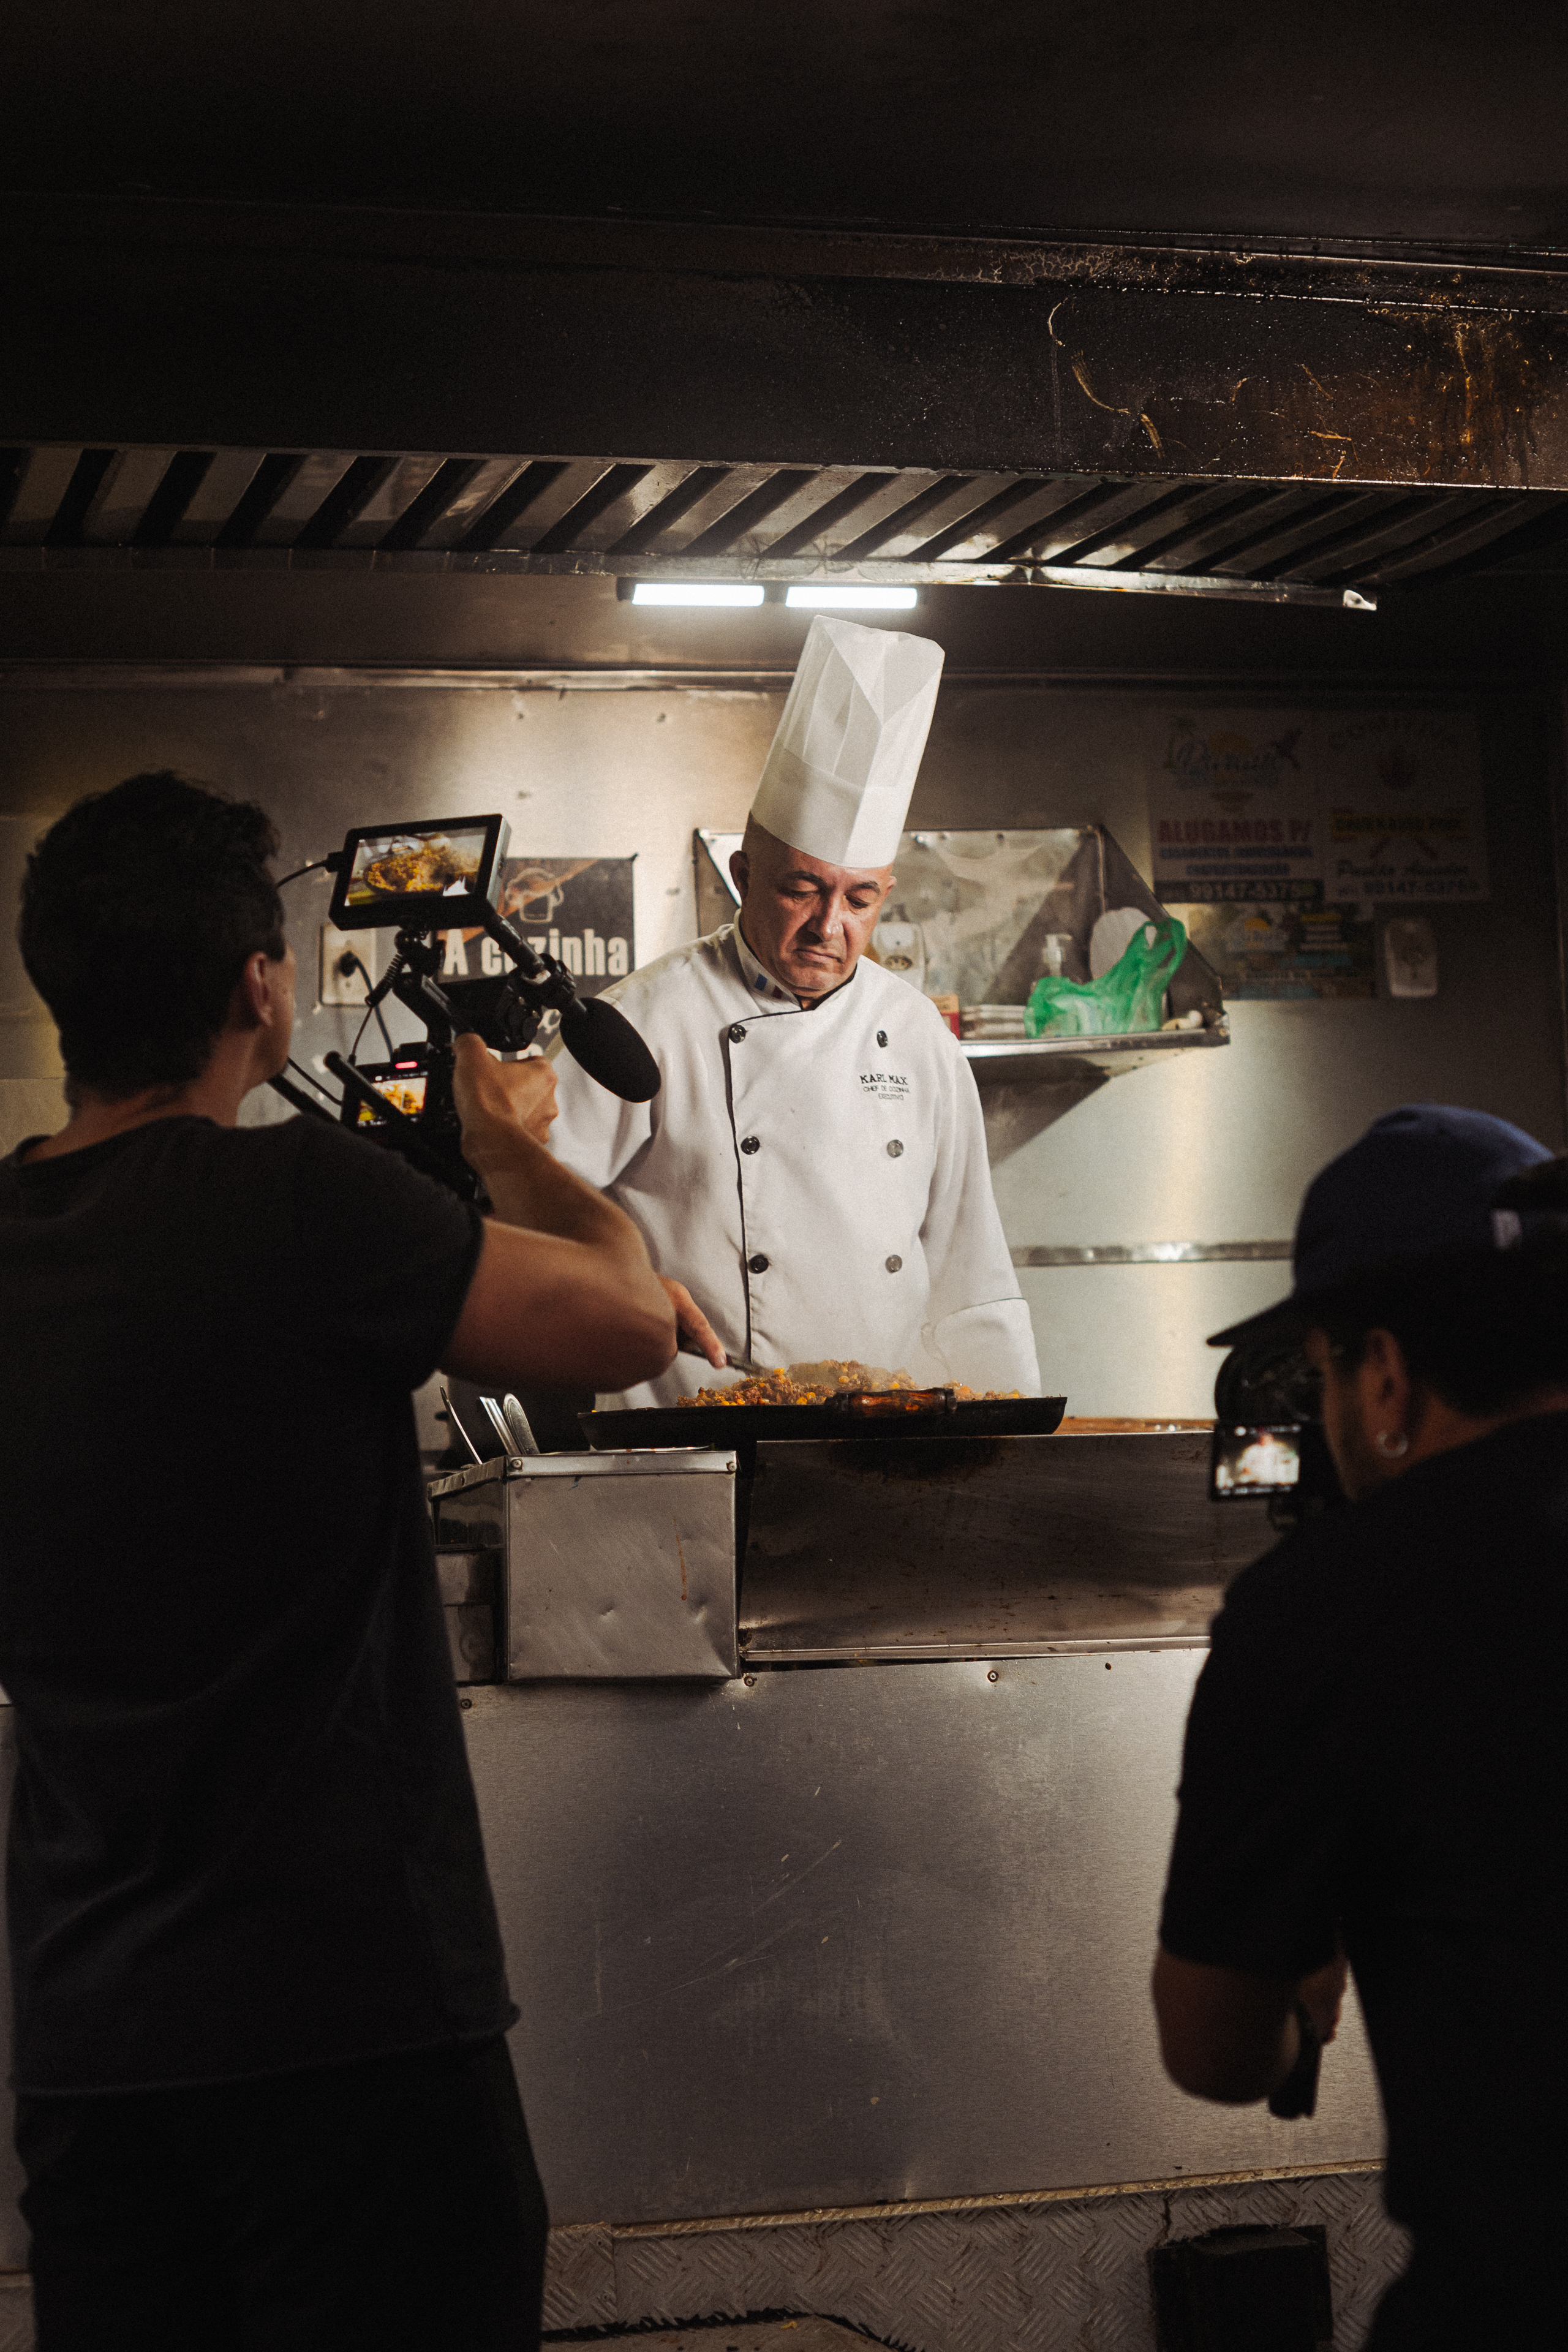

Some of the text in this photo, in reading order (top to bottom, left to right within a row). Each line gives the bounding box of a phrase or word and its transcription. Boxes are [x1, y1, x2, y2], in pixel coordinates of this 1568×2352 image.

[1159, 819, 1284, 842] ALUGAMOS
[443, 928, 469, 975] A
[859, 1074, 908, 1085] KARL MAX
